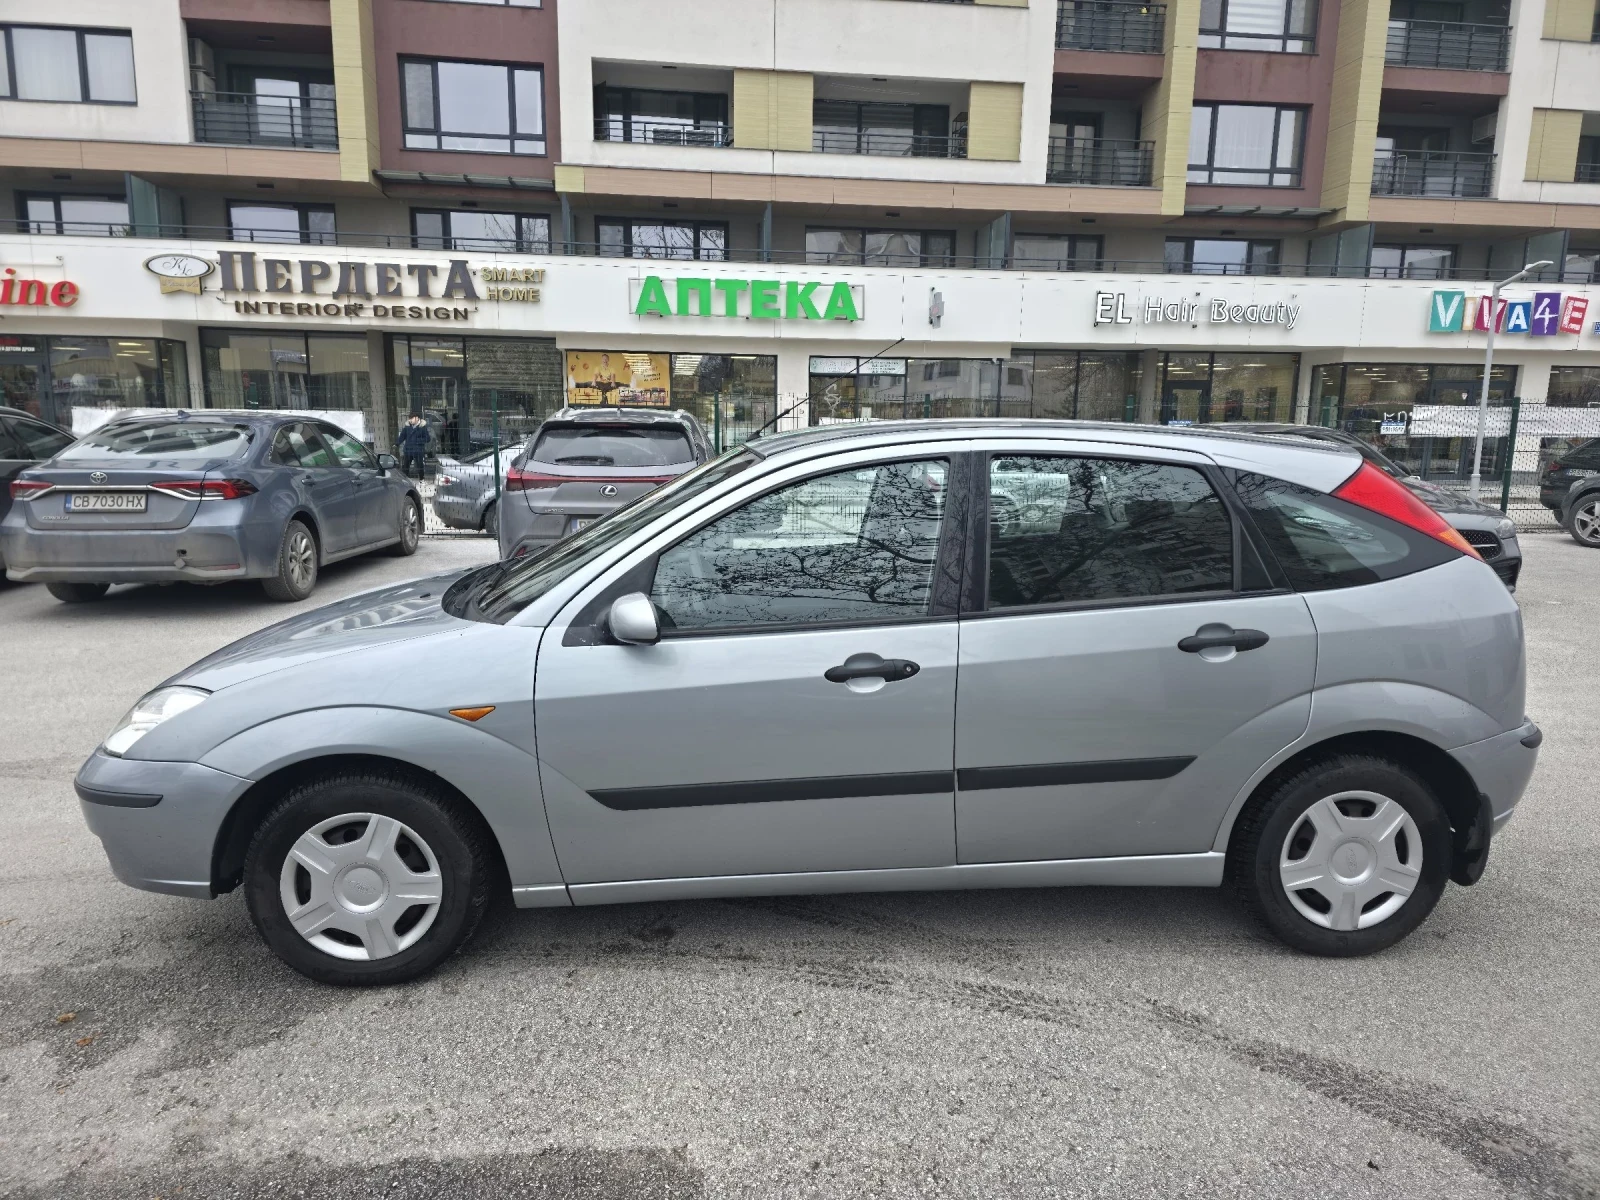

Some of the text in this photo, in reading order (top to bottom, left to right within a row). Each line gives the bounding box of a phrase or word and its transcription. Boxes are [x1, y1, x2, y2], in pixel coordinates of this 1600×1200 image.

[0, 268, 79, 308] ine
[217, 251, 480, 300] ПЕРДЕТА
[480, 267, 546, 283] SMART
[486, 287, 541, 302] HOME
[635, 276, 859, 320] АПТЕКА
[234, 300, 468, 321] INTERIOR DESIGN
[1096, 293, 1300, 330] EL Hair Beauty
[73, 495, 144, 508] CB 7030 HX
